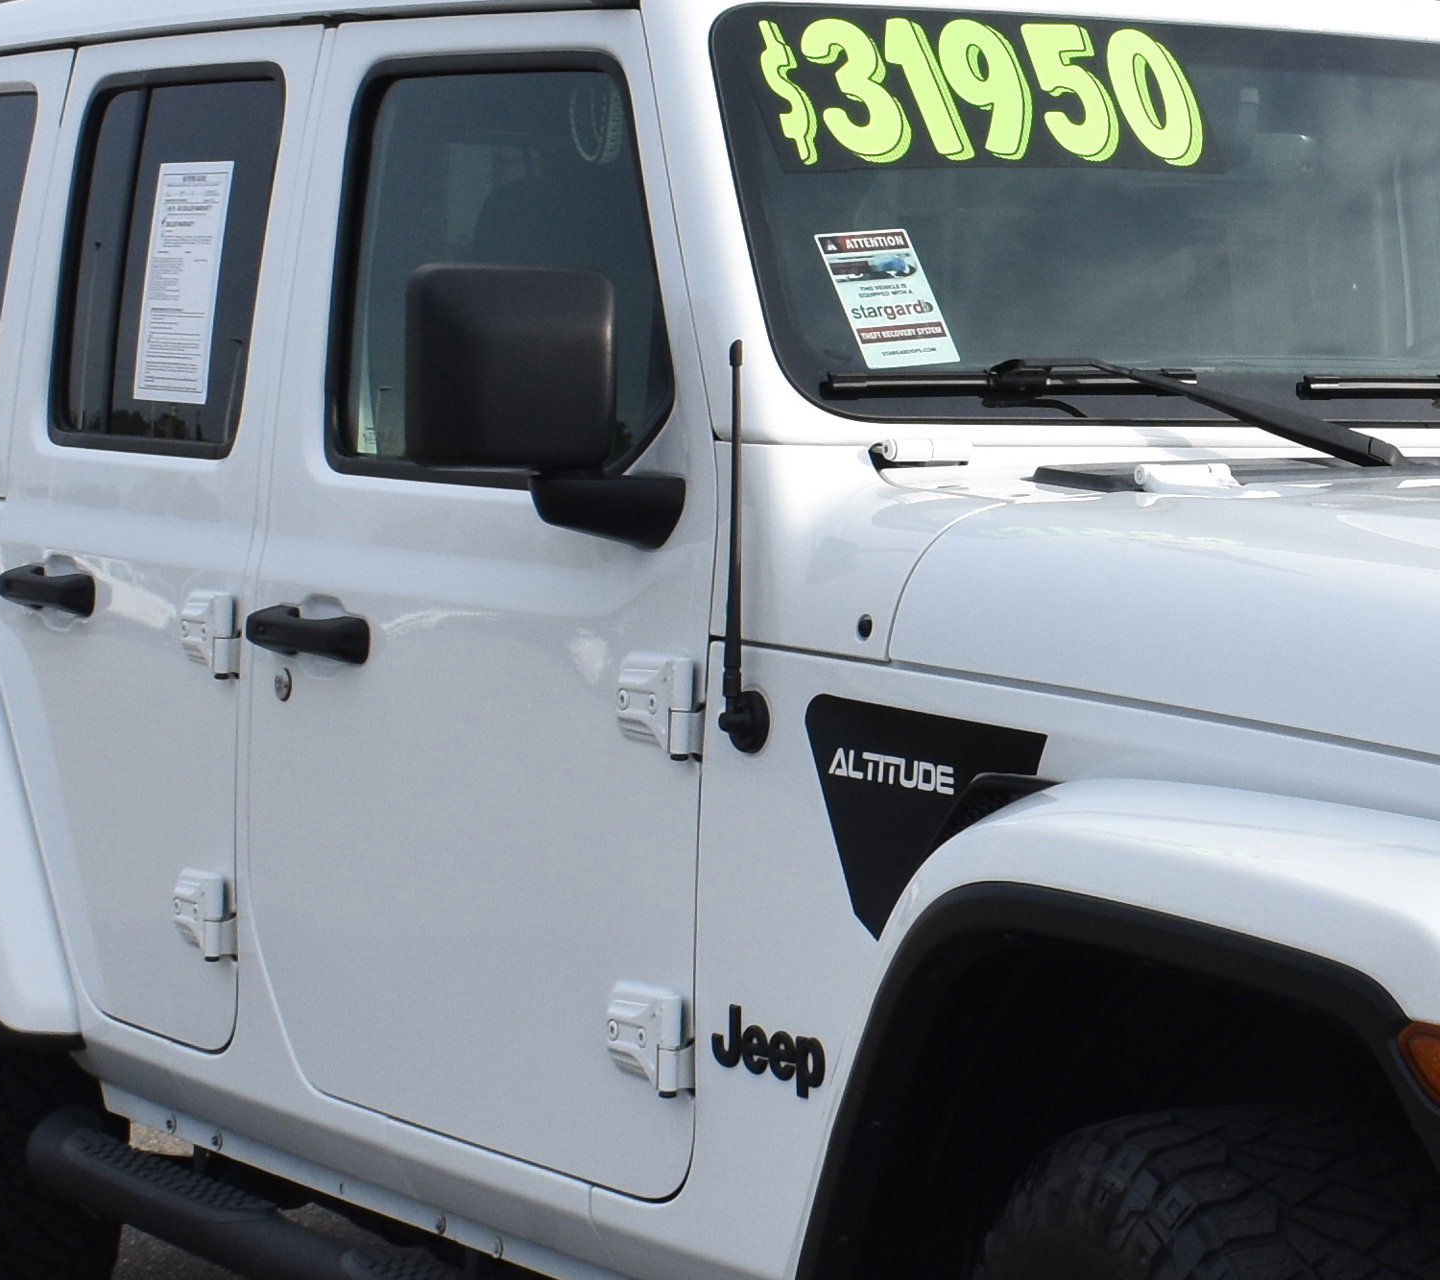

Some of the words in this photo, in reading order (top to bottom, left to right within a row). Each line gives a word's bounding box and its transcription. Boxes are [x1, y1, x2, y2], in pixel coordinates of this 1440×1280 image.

[758, 17, 1203, 167] $31950
[845, 234, 905, 250] ATTENTION
[851, 299, 924, 320] stargard
[882, 328, 916, 338] RECOVERY
[916, 326, 943, 335] SYSTEM
[828, 746, 955, 796] ALTITUDE
[711, 1003, 826, 1100] Jeep
